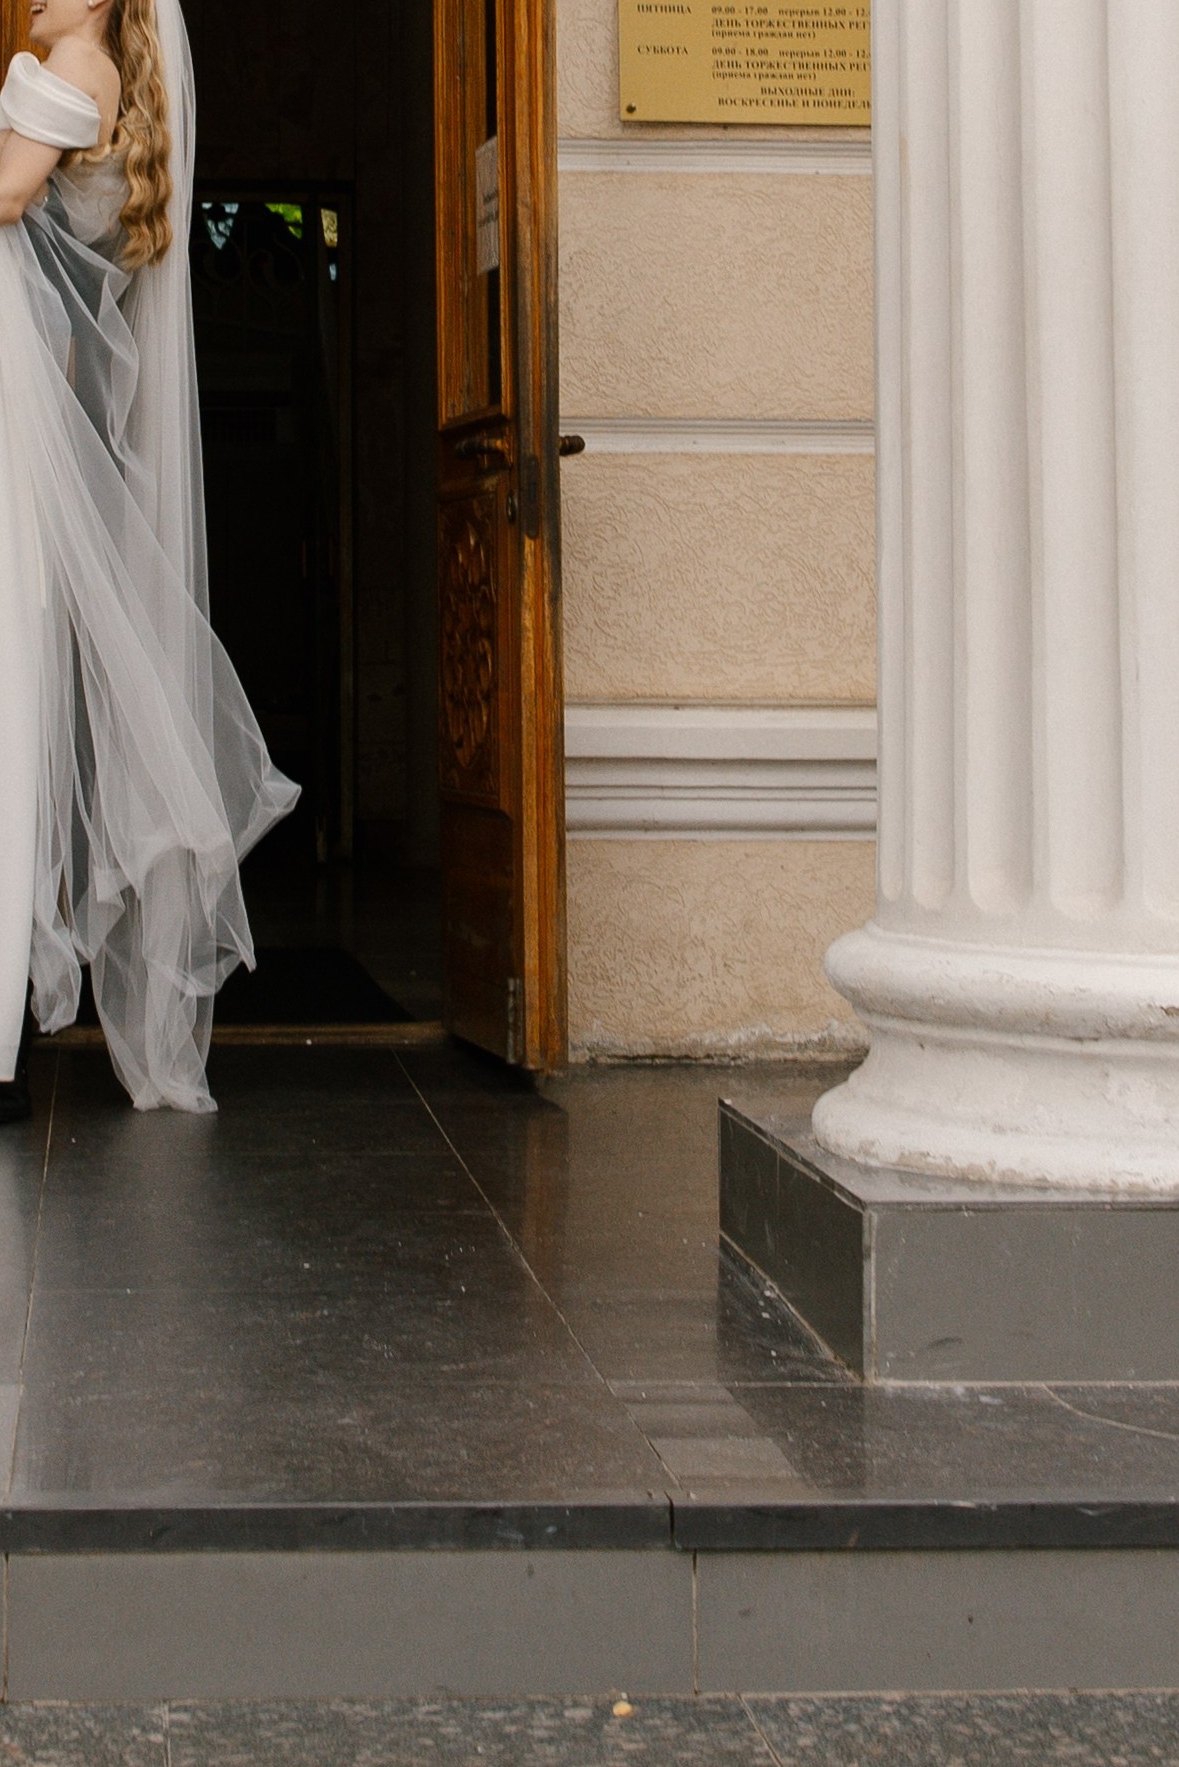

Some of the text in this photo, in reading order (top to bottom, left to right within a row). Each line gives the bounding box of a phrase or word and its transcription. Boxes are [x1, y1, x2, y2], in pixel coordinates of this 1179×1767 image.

[637, 4, 691, 14] ПЯТНИЦА
[779, 9, 819, 17] перерыв
[824, 8, 846, 16] 12.00
[856, 8, 870, 16] 12.
[712, 18, 741, 28] ДЕНЬ
[745, 19, 845, 28] ТОРЖЕСТВЕННЫХ
[711, 30, 750, 38] (приема
[754, 31, 793, 39] граждан
[638, 46, 689, 54] СУББОТА
[746, 48, 768, 56] 18.00
[824, 49, 847, 57] 12.00
[712, 60, 741, 69] ДЕНЬ
[746, 61, 846, 71] ТОРЖЕСТВЕННЫХ
[713, 72, 751, 80] (приема
[761, 87, 855, 97] ВЫХОДНЫЕ ДНИ:
[718, 98, 798, 108] ВОСКРЕСЕНЬЕ
[802, 100, 809, 108] И
